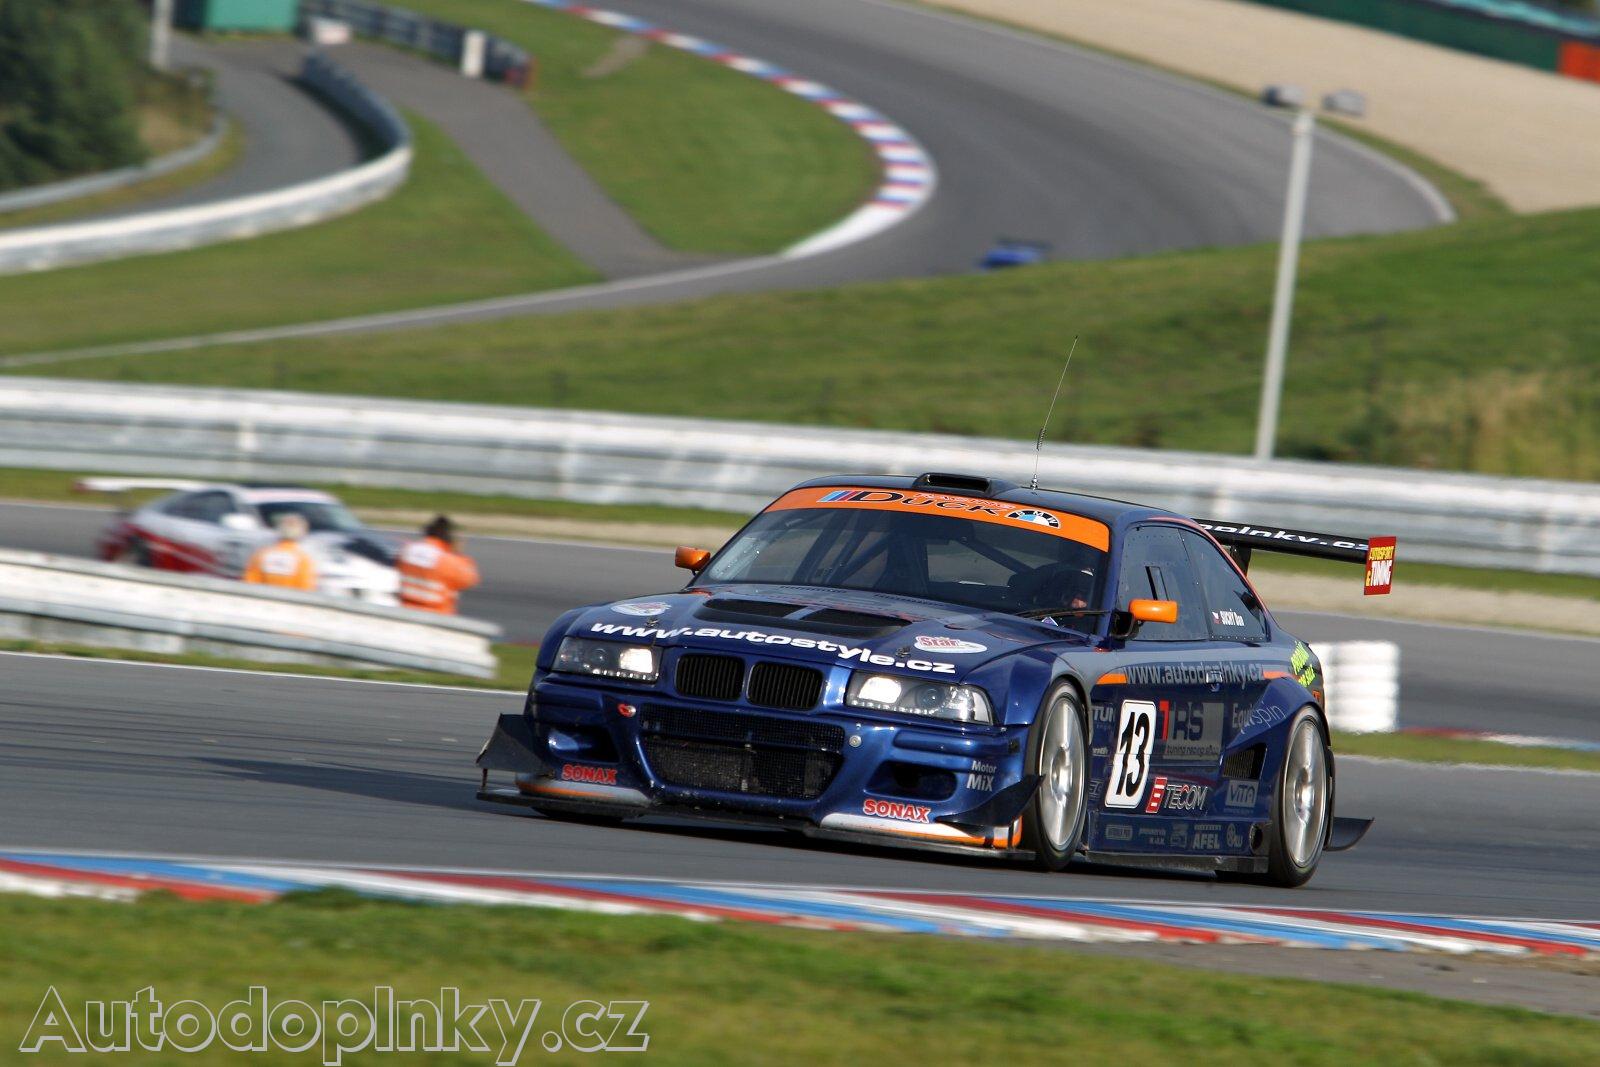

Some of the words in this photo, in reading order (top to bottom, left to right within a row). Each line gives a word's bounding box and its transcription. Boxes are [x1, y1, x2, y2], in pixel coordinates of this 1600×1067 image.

[590, 622, 956, 674] www.autostyle.cz
[1115, 711, 1150, 797] 13
[561, 763, 618, 785] SONAX
[971, 760, 997, 774] Motor
[863, 798, 932, 823] SONAX
